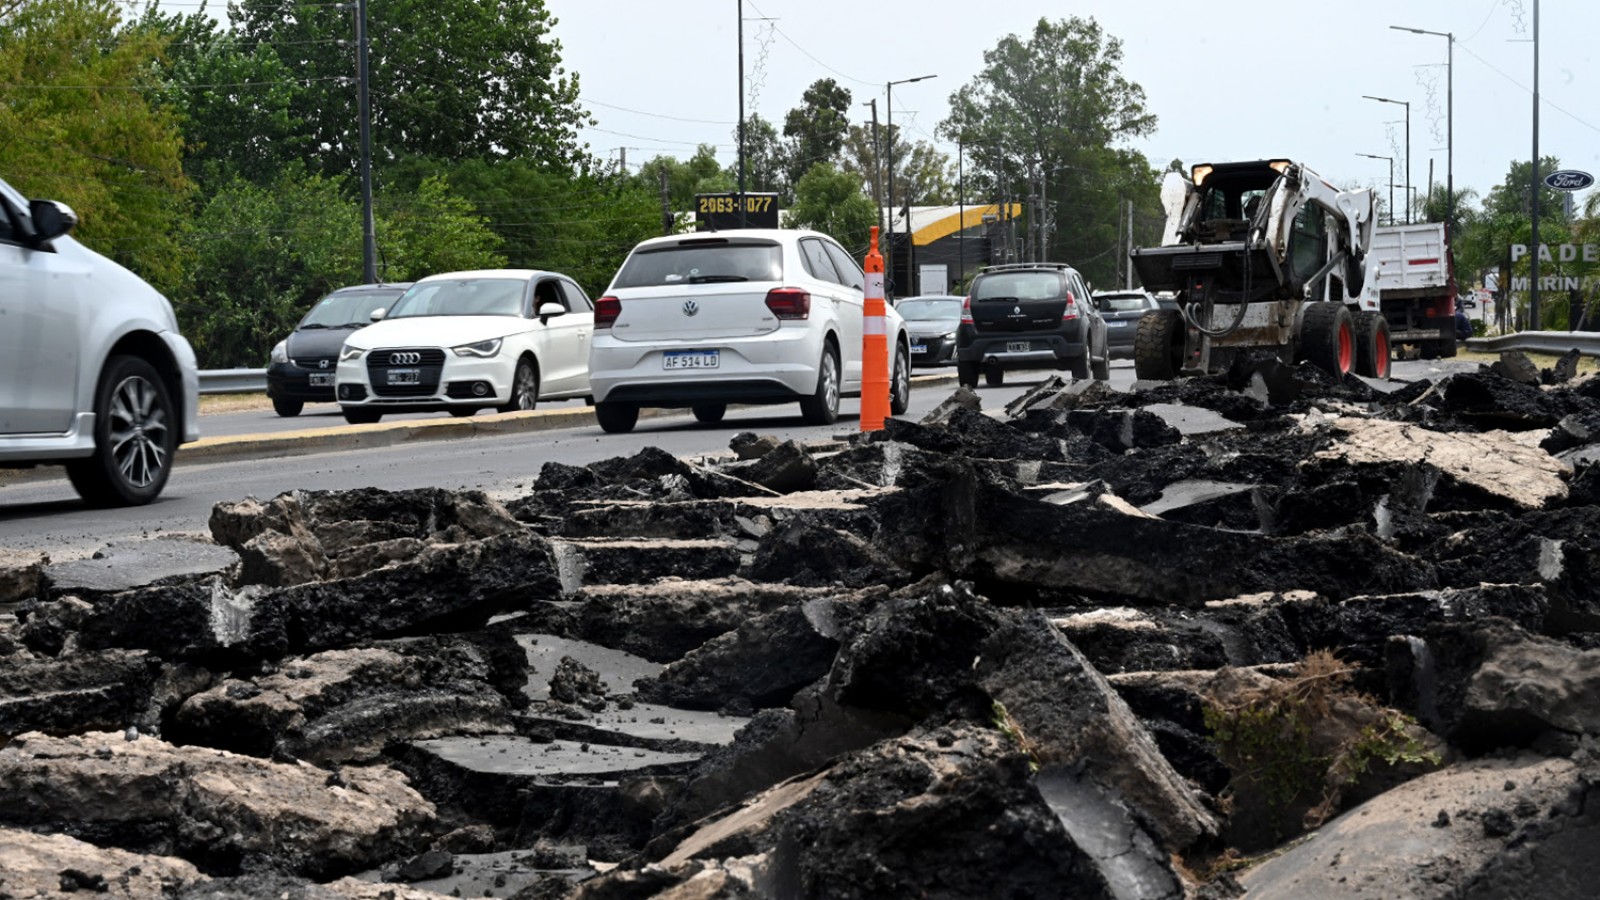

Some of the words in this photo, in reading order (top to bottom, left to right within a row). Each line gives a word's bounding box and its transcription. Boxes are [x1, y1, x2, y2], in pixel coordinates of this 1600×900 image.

[700, 196, 772, 213] 2063-077
[665, 356, 679, 368] AF
[681, 356, 701, 367] 514
